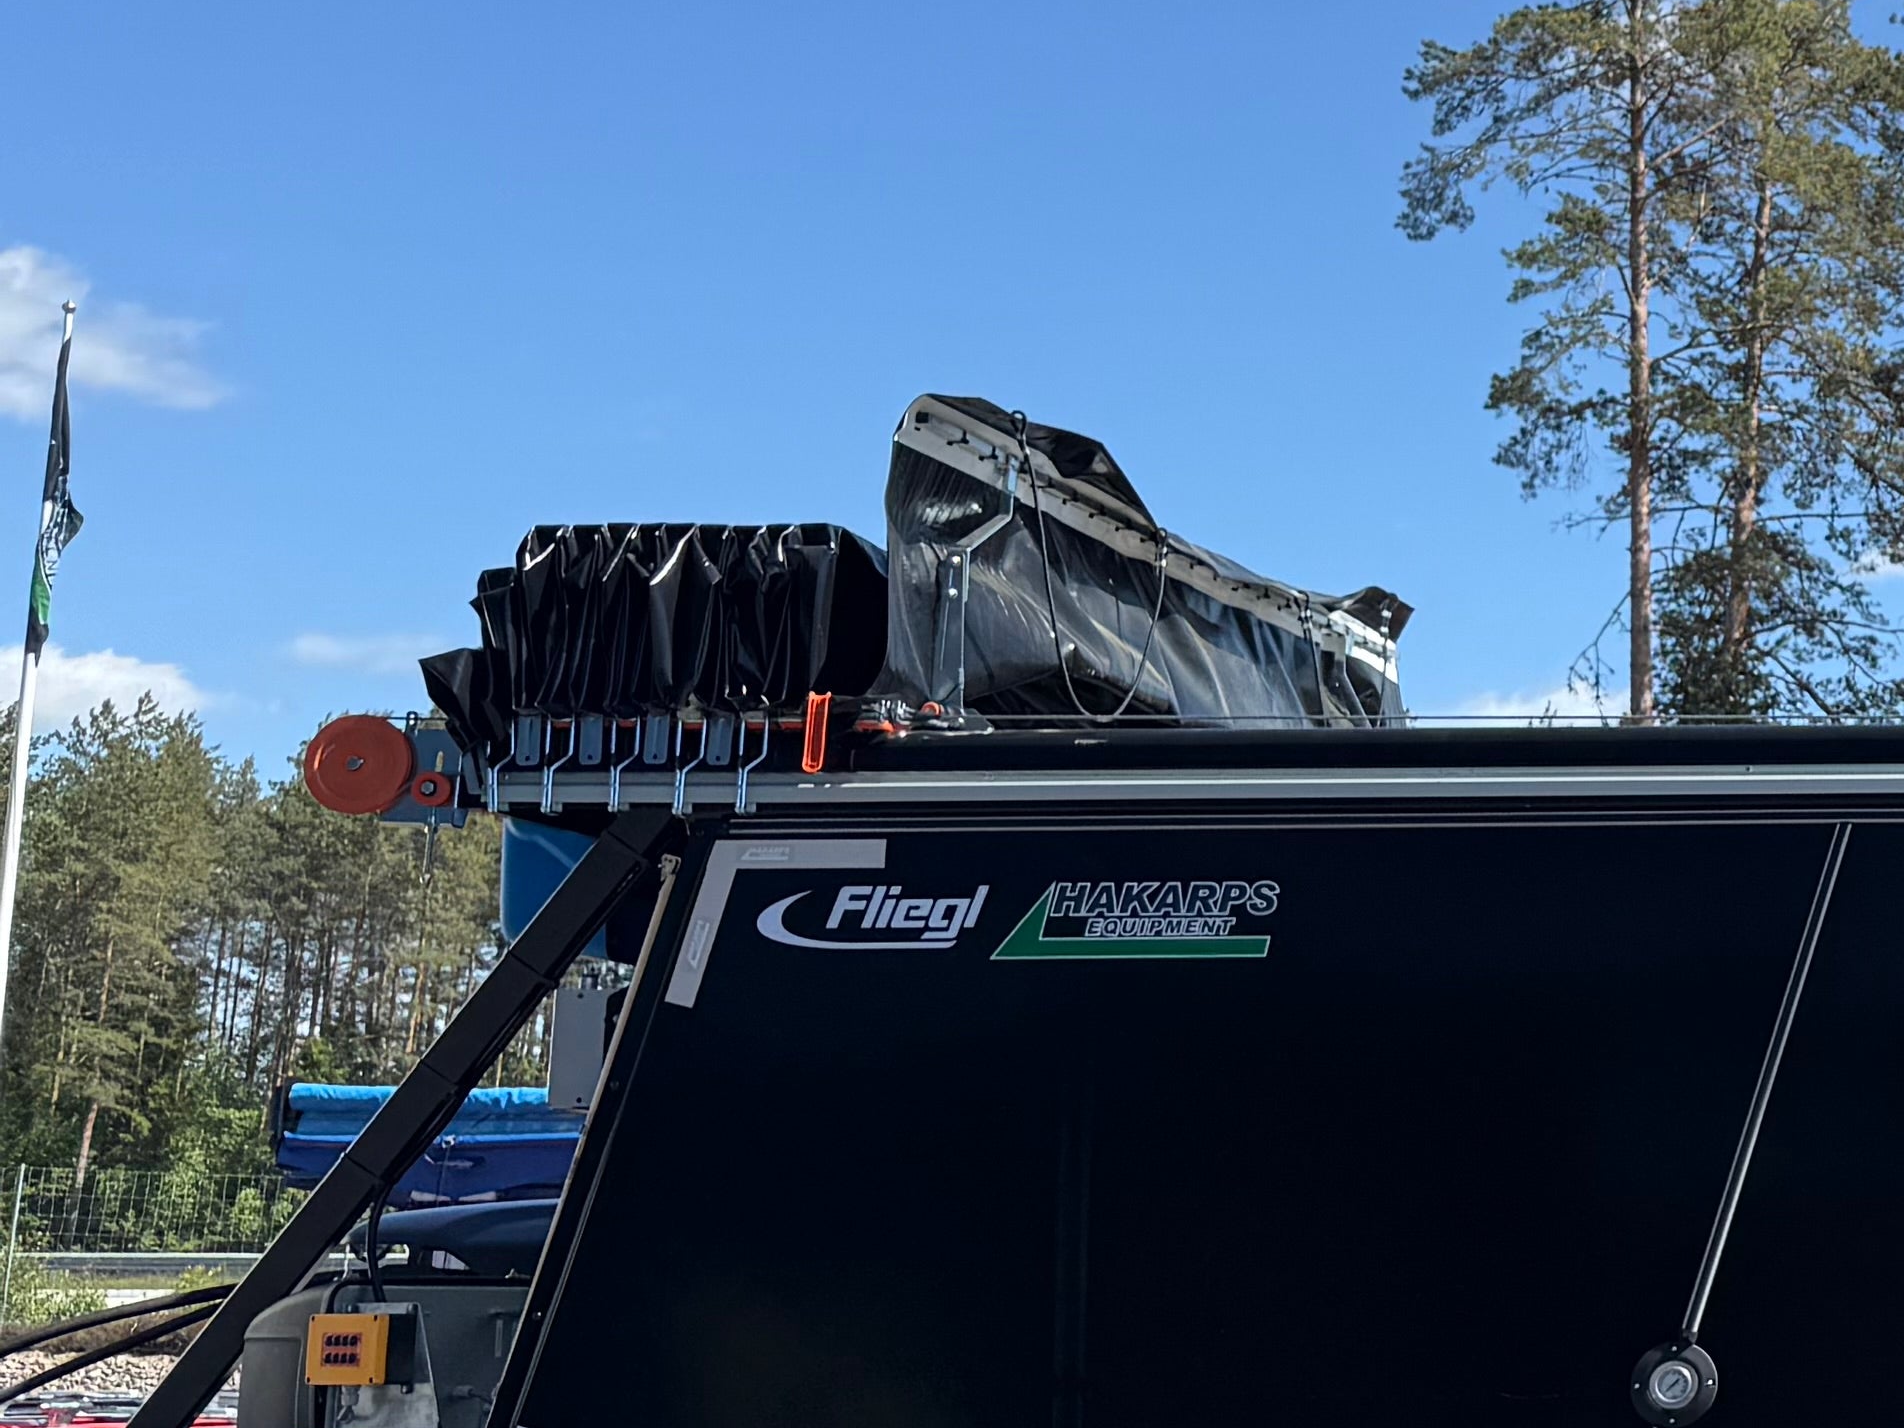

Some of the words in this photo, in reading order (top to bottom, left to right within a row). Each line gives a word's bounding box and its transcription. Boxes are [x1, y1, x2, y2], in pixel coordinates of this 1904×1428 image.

[825, 885, 990, 939] Fliegl
[1050, 880, 1280, 916] HAKARPS
[1084, 917, 1236, 937] EQUIPMENT
